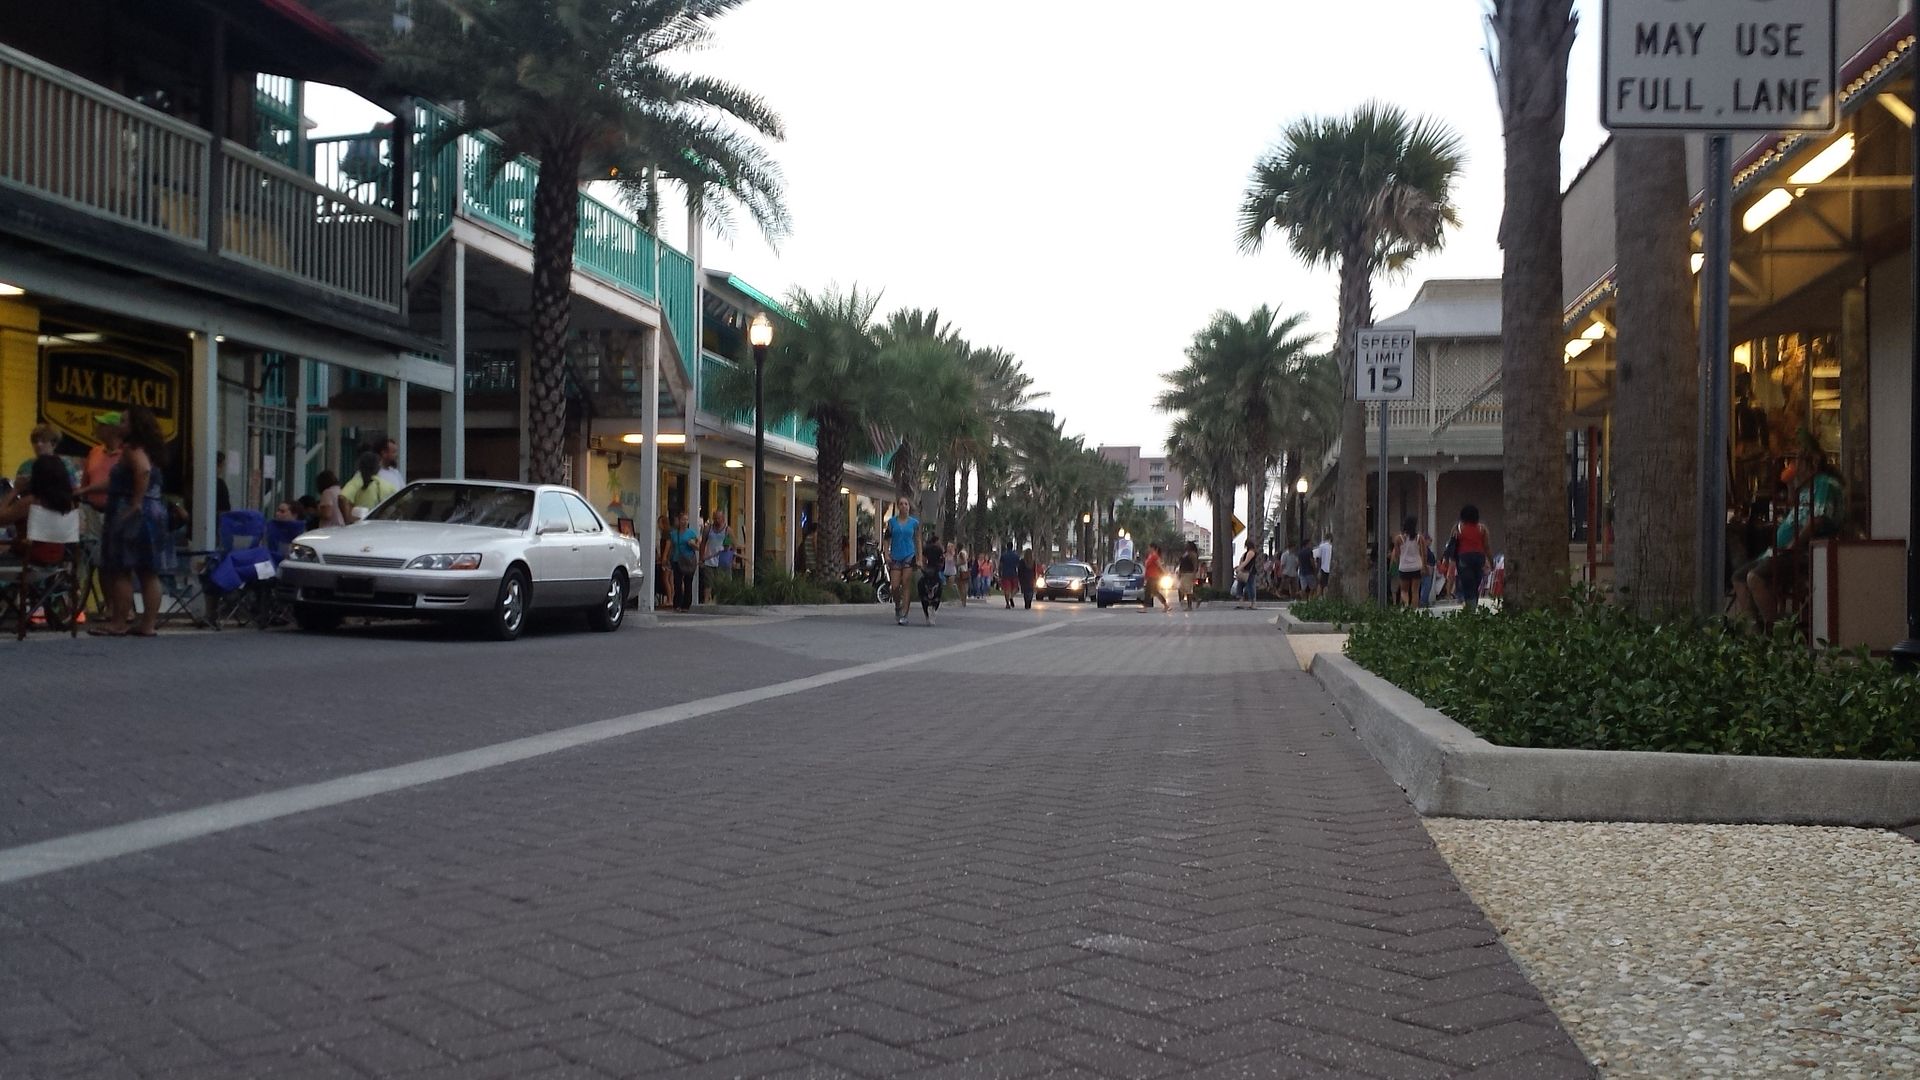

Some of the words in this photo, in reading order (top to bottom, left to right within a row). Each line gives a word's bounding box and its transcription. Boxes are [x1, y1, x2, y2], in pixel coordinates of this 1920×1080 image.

[1635, 21, 1707, 56] MAY
[1735, 22, 1804, 56] USE
[1617, 76, 1704, 112] FULL
[1732, 78, 1820, 112] LANE
[1361, 335, 1410, 349] SPEED
[1366, 351, 1403, 364] LIMIT
[56, 366, 96, 399] JAX
[103, 372, 167, 409] BEACH
[1367, 366, 1402, 394] 15
